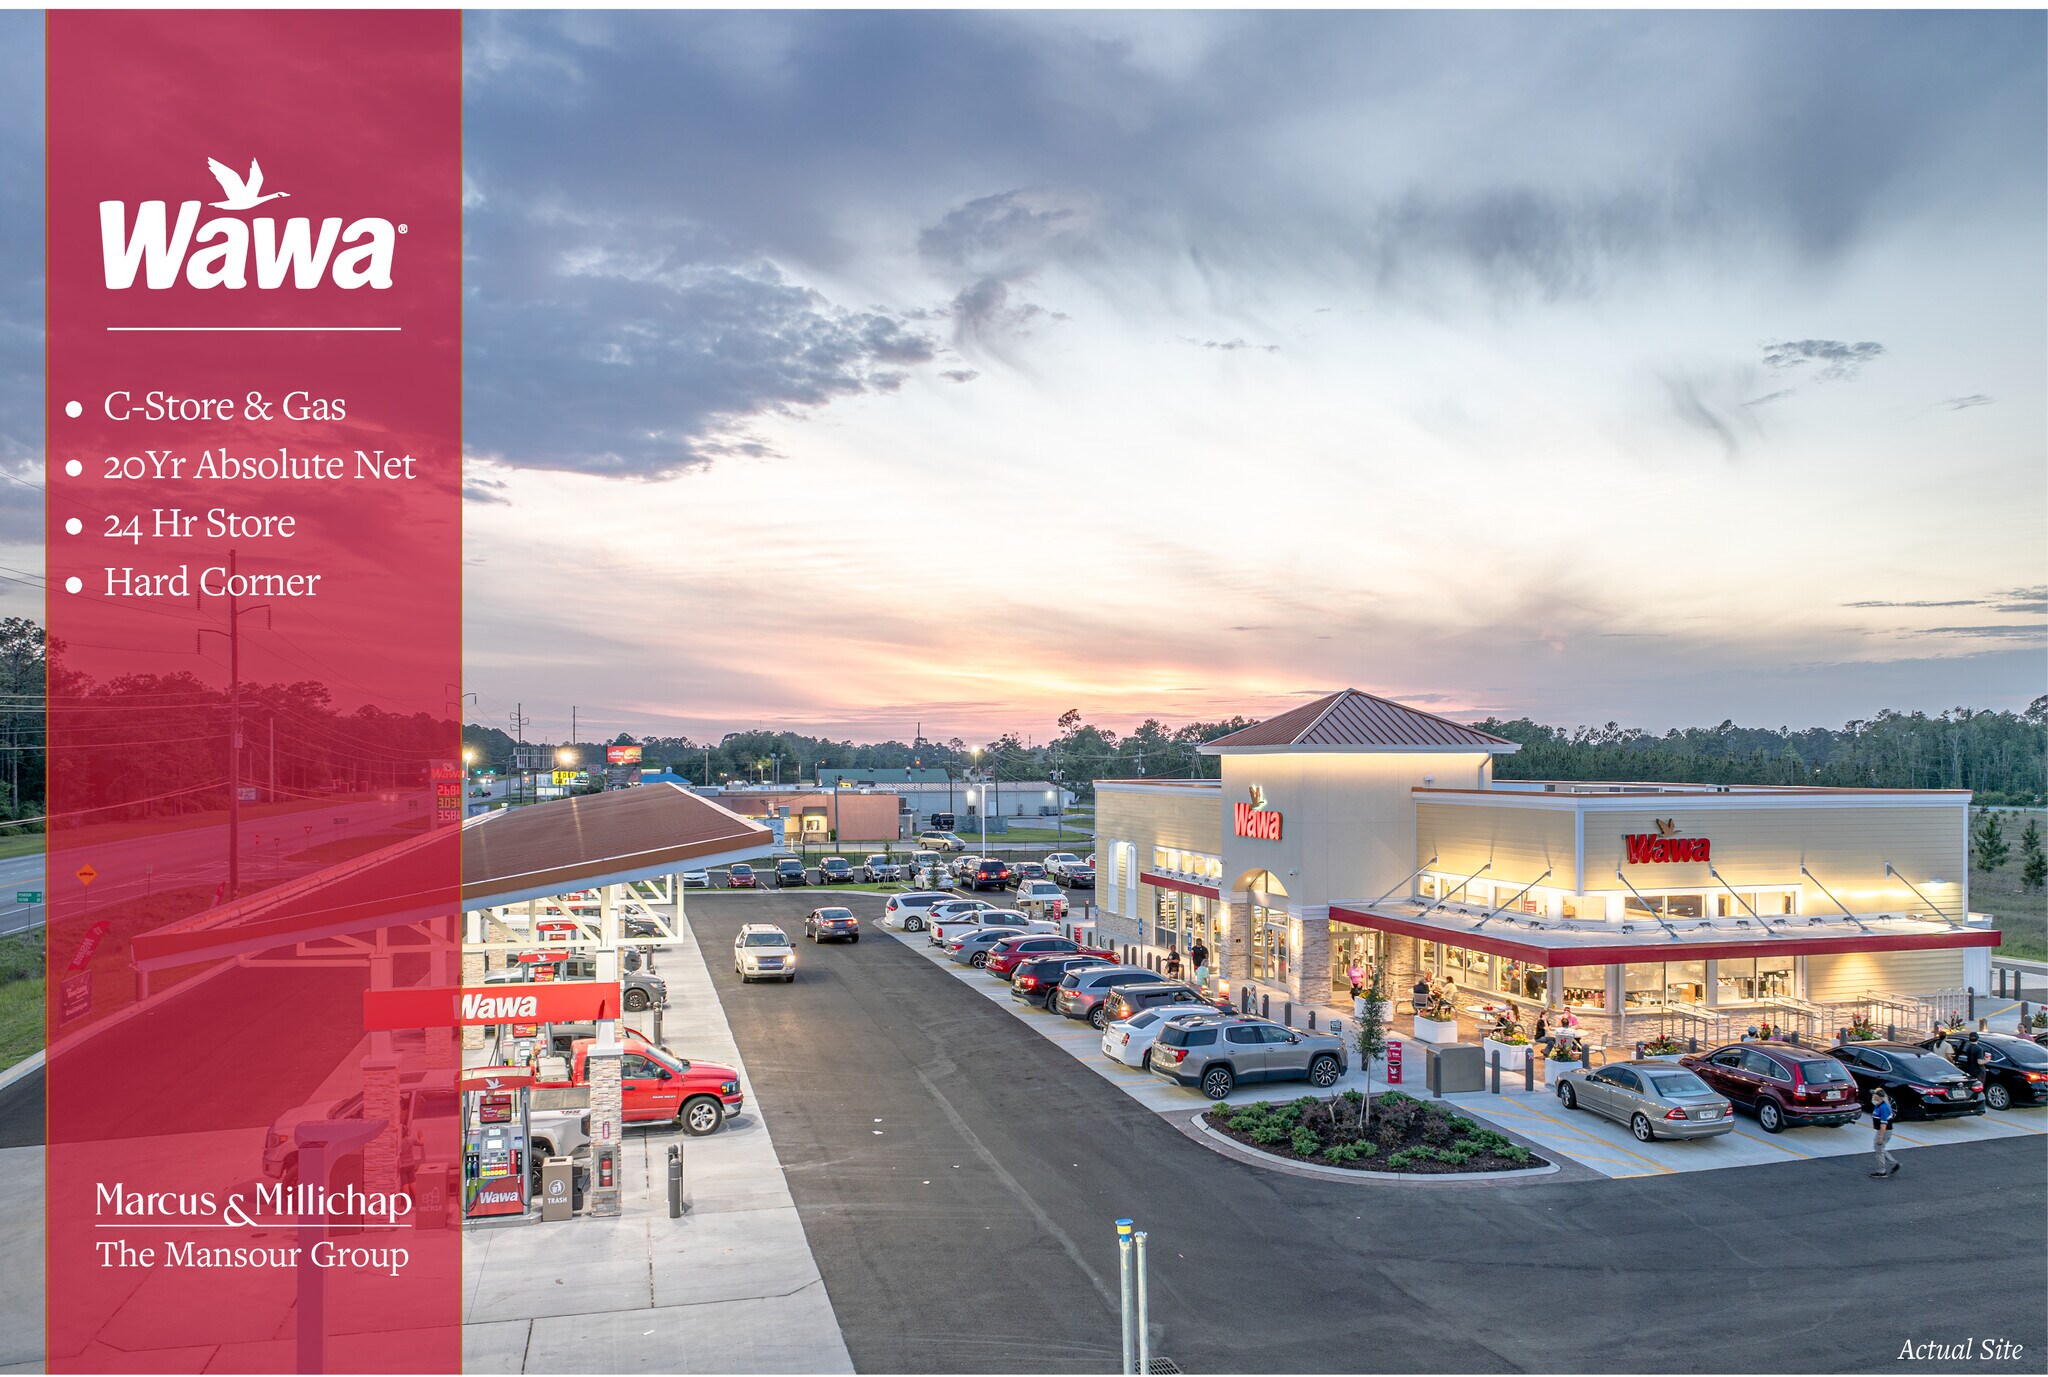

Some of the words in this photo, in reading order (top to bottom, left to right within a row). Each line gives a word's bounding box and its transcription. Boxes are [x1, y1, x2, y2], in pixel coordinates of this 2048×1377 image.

[1234, 801, 1283, 841] Wawa
[1624, 833, 1711, 865] Wawa
[453, 993, 537, 1020] Wawa
[480, 1191, 519, 1204] Wawa
[547, 1197, 568, 1205] TRASH
